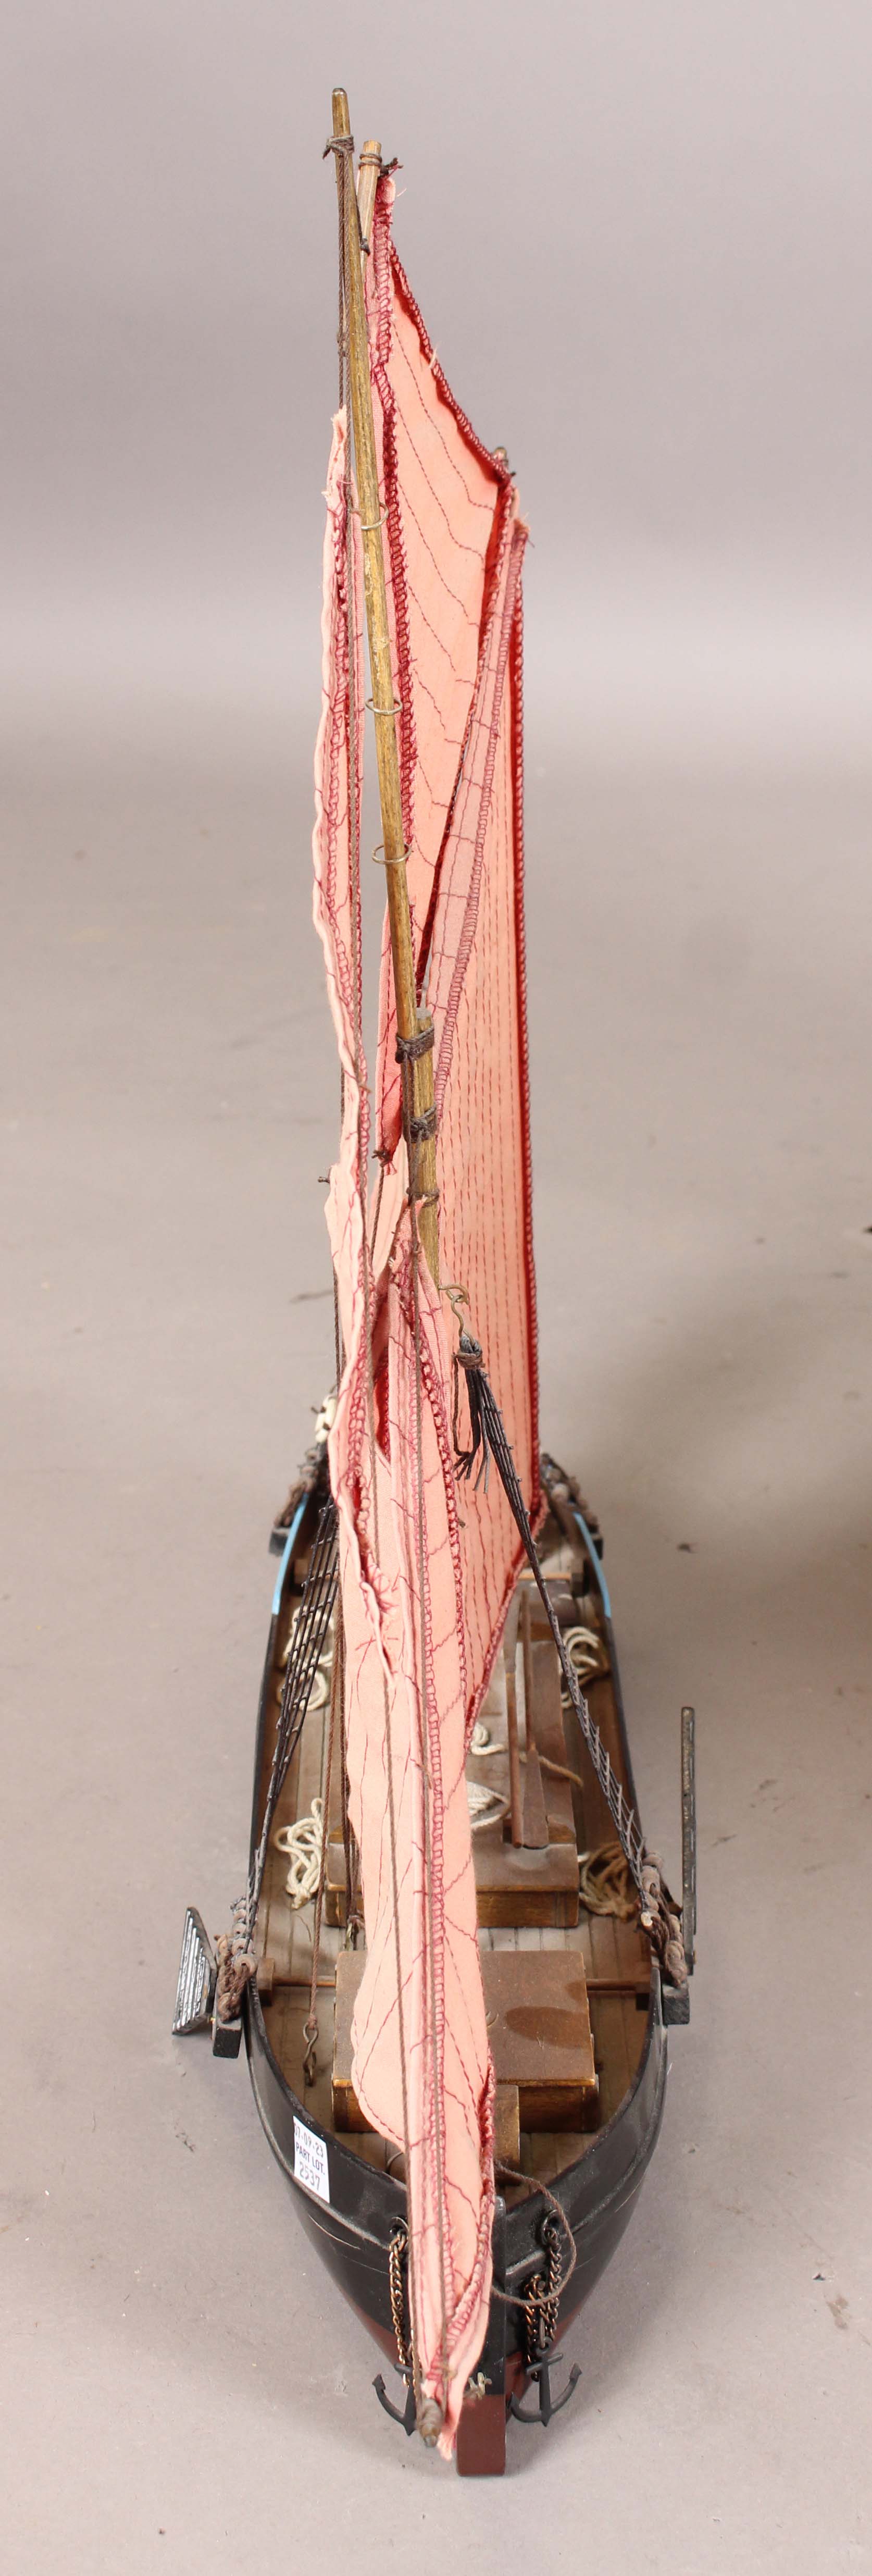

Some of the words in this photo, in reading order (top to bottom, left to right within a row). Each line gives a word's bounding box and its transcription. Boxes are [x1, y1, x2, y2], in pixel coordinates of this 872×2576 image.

[296, 2142, 310, 2162] PART
[313, 2156, 326, 2175] LOT.
[300, 2161, 320, 2190] 2537
